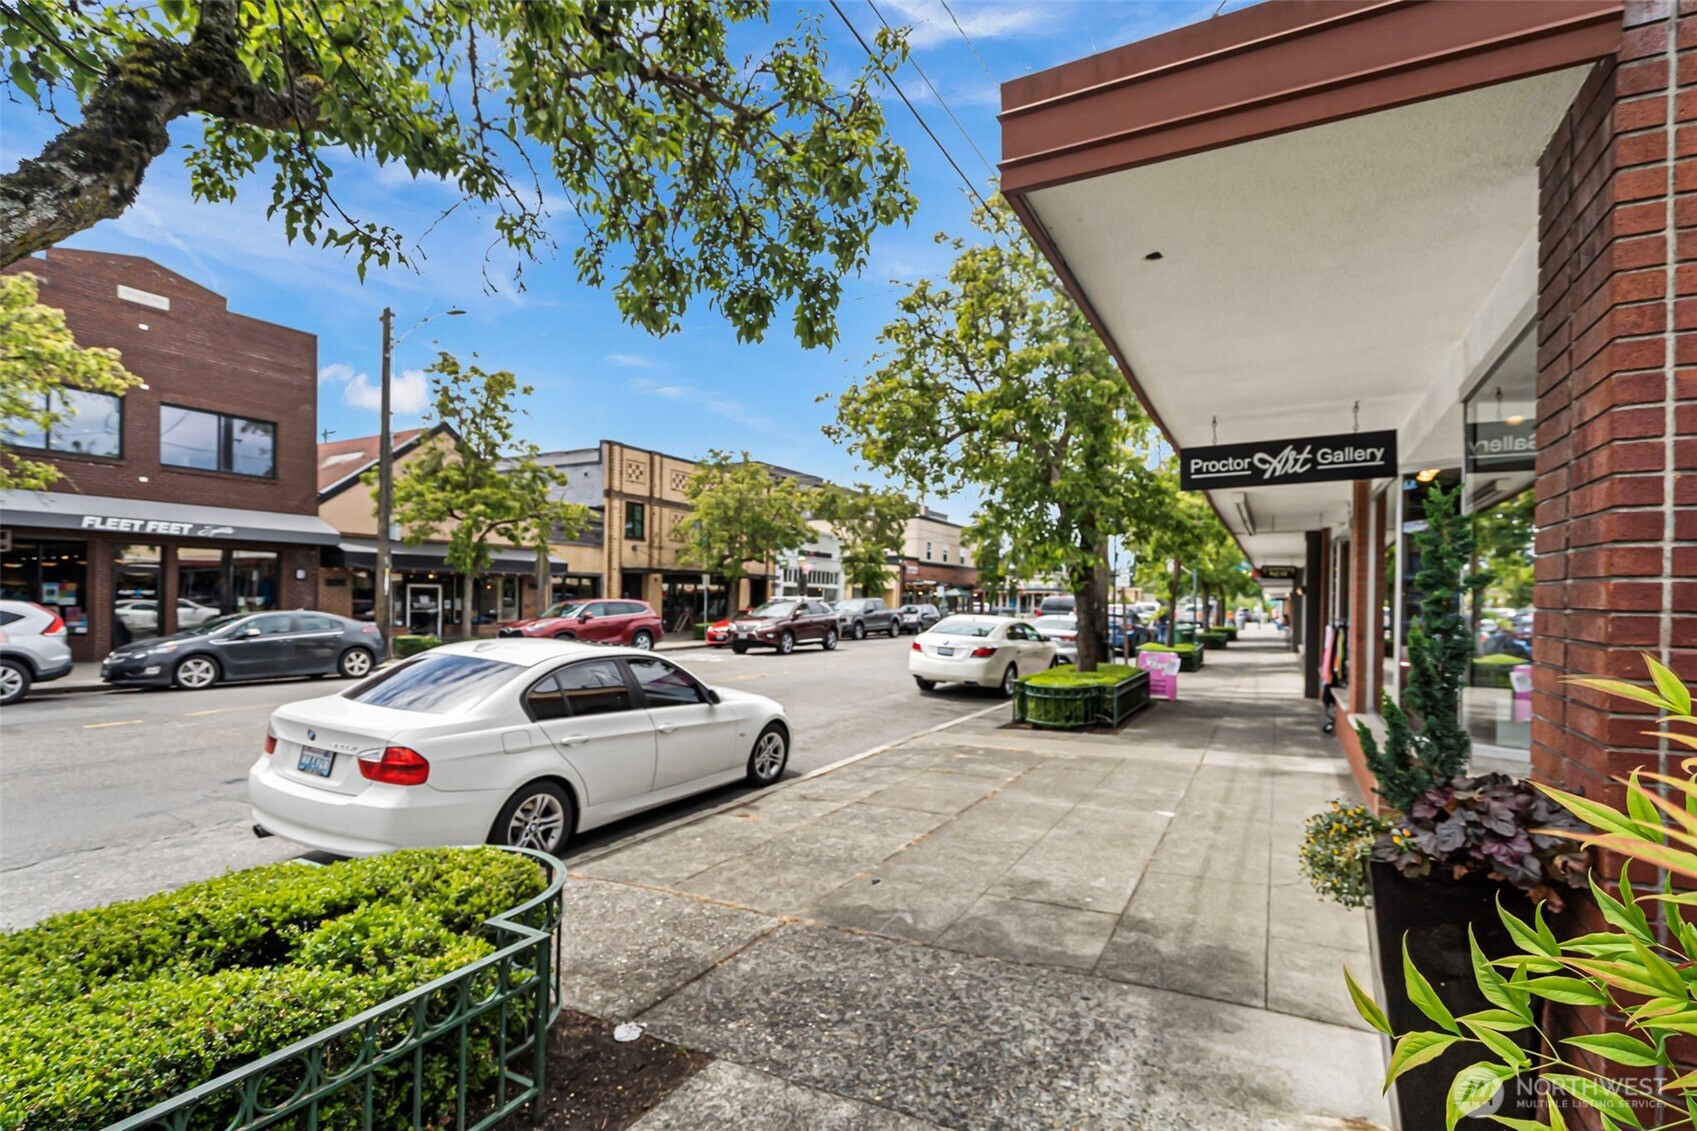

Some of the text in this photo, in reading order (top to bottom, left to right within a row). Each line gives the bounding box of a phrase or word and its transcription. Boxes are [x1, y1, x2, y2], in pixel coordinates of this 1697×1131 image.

[1190, 445, 1385, 480] Proctor Art Gallery
[81, 515, 145, 532] FLEET
[145, 520, 194, 536] FEET
